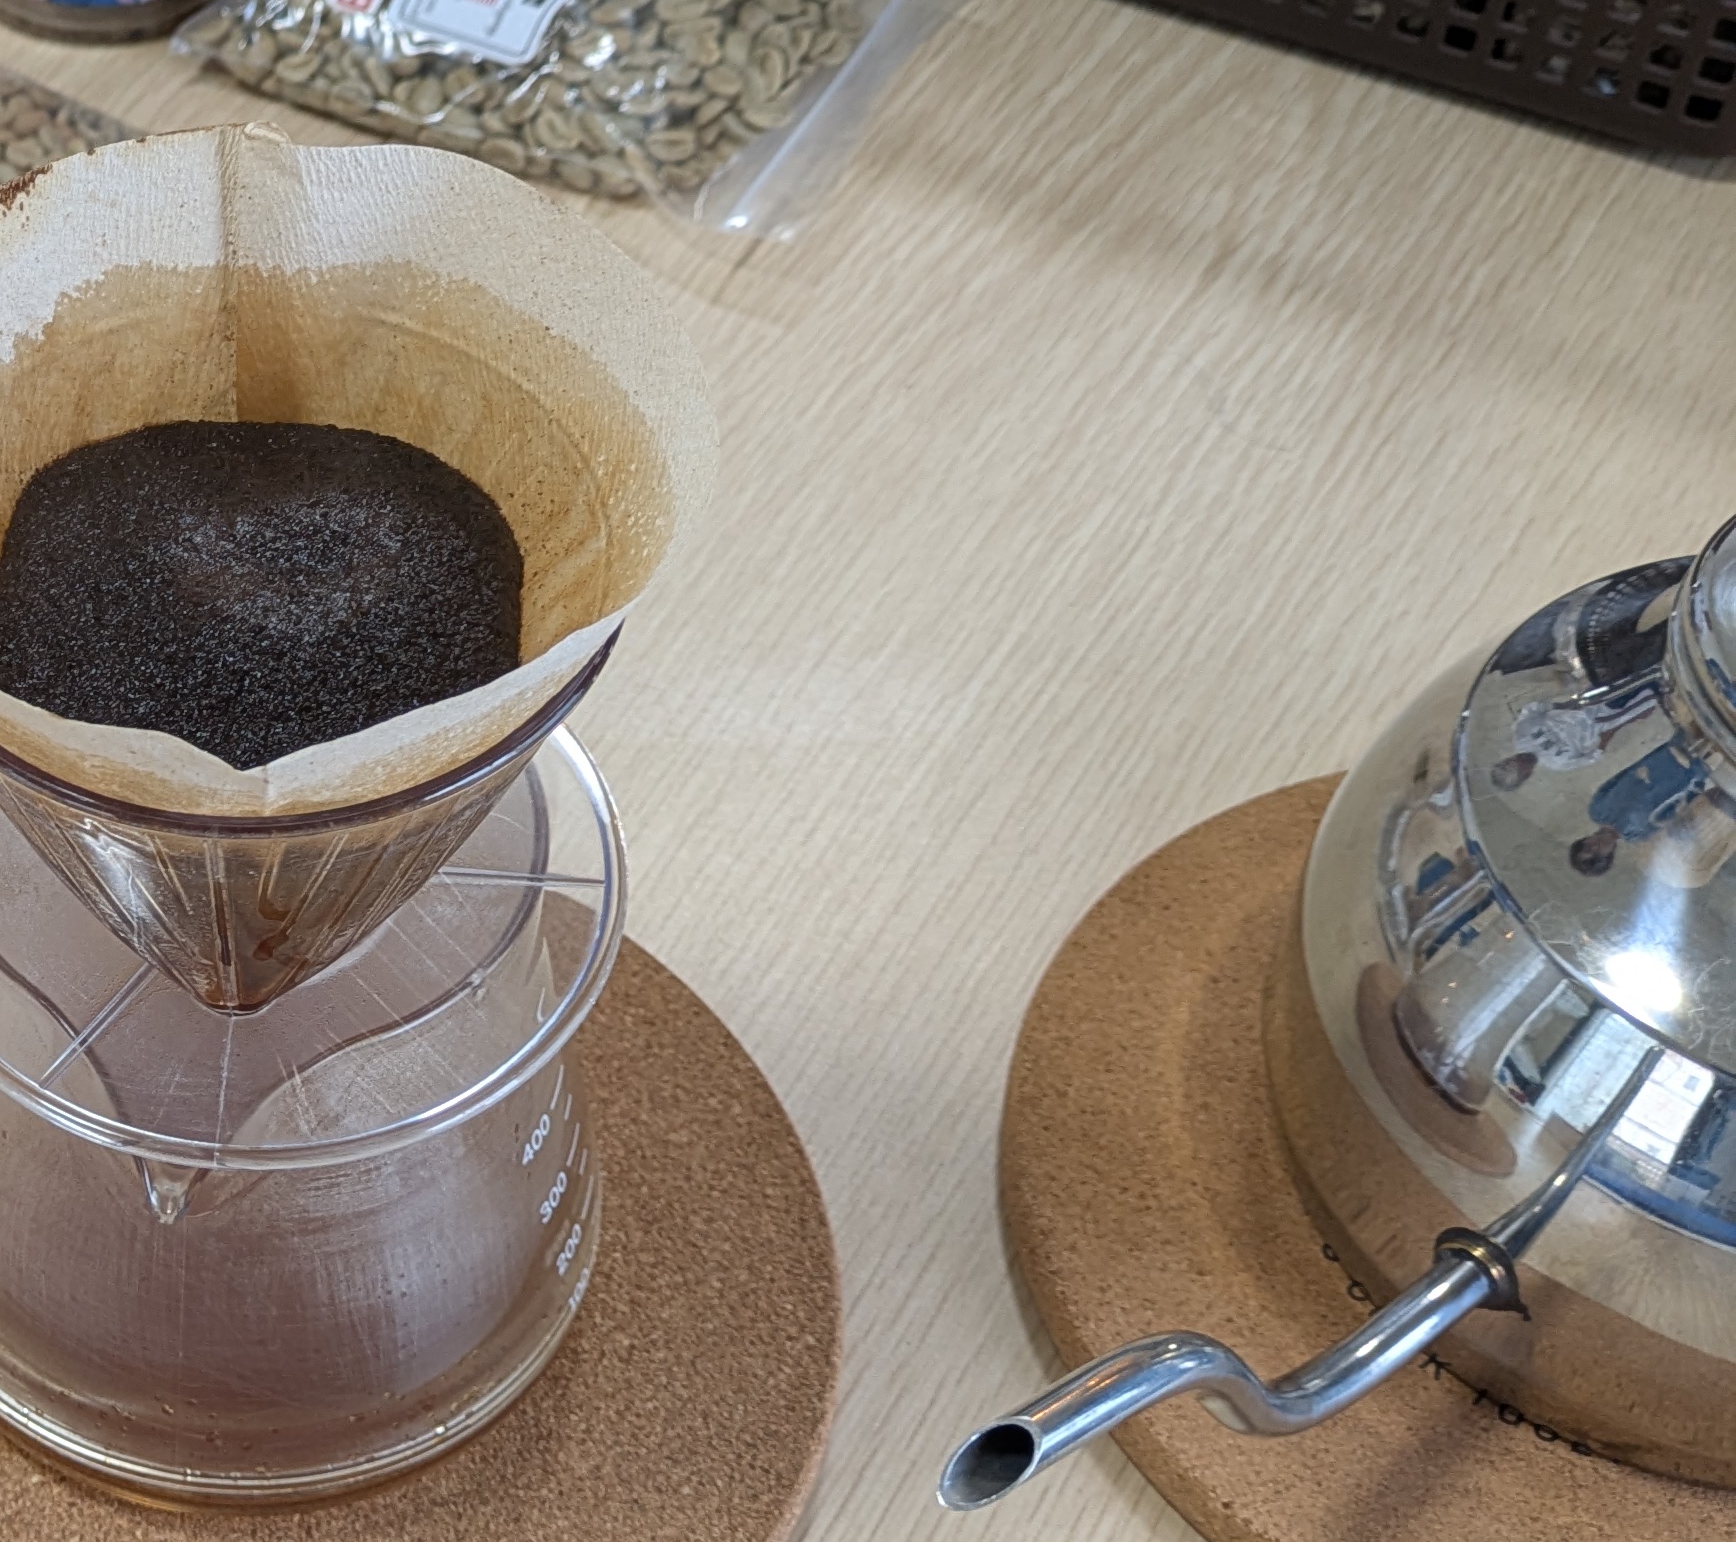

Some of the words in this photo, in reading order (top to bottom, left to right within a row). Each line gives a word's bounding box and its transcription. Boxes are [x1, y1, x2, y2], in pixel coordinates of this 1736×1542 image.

[521, 1114, 552, 1166] 400
[539, 1171, 568, 1224] 300
[556, 1223, 583, 1276] 200
[568, 1267, 590, 1309] 100
